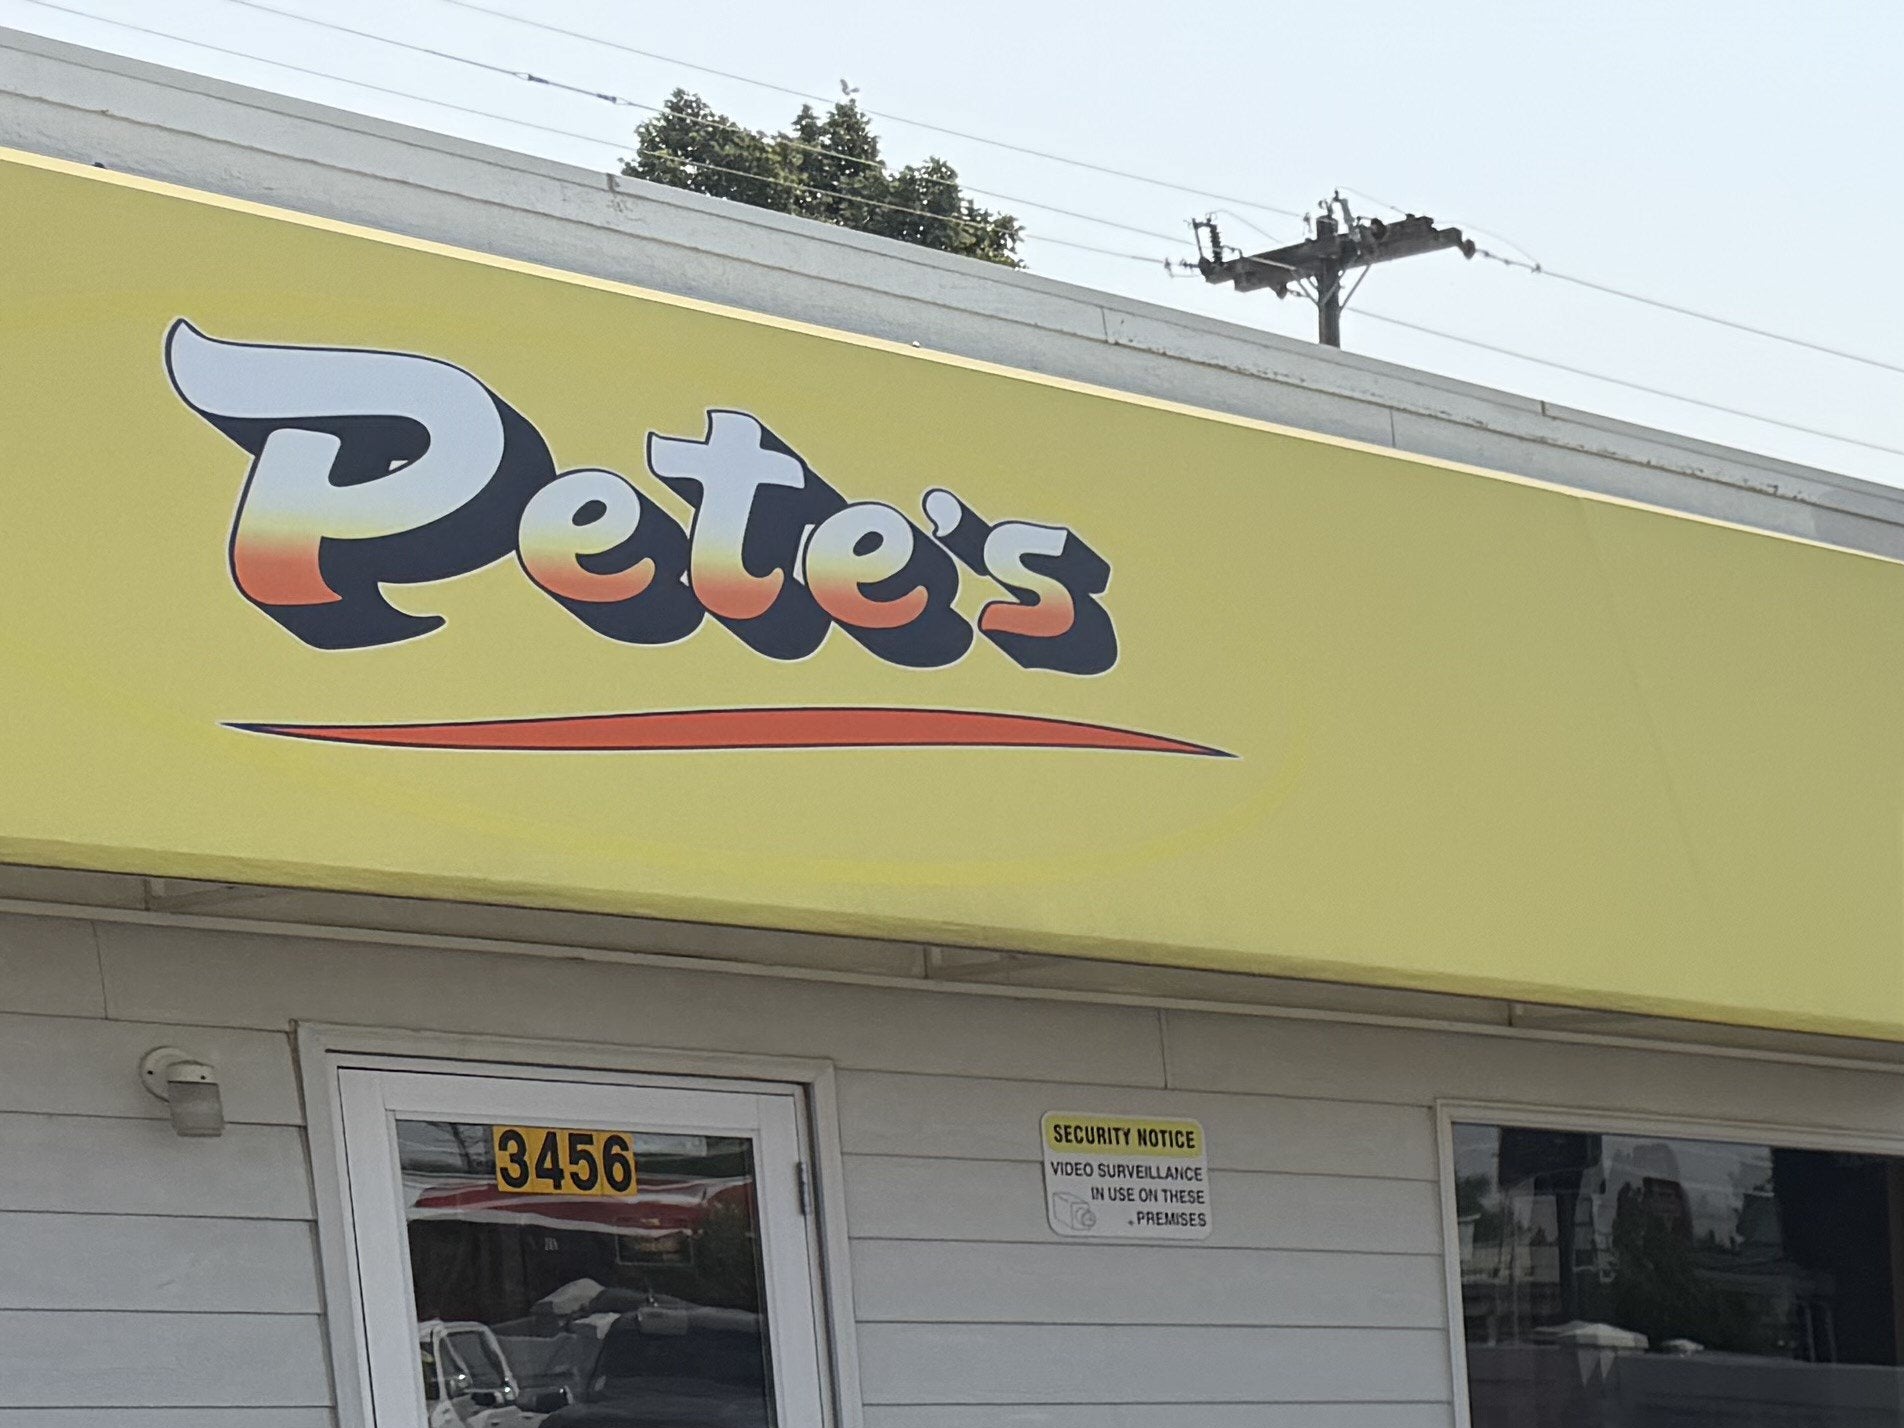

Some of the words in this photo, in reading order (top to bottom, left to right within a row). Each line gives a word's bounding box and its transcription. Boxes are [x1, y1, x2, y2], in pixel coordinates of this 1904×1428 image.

[164, 317, 1119, 676] Pete's
[1053, 1123, 1131, 1146] SECURITY
[1137, 1127, 1196, 1149] NOTICE
[497, 1128, 632, 1193] 3456
[1050, 1161, 1094, 1177] VIDEO
[1097, 1162, 1203, 1182] SURVEILLANCE
[1091, 1187, 1105, 1201] IN
[1108, 1187, 1135, 1202] USE
[1138, 1188, 1158, 1202] ON
[1161, 1188, 1206, 1205] THESE
[1136, 1210, 1207, 1228] PREMISES
